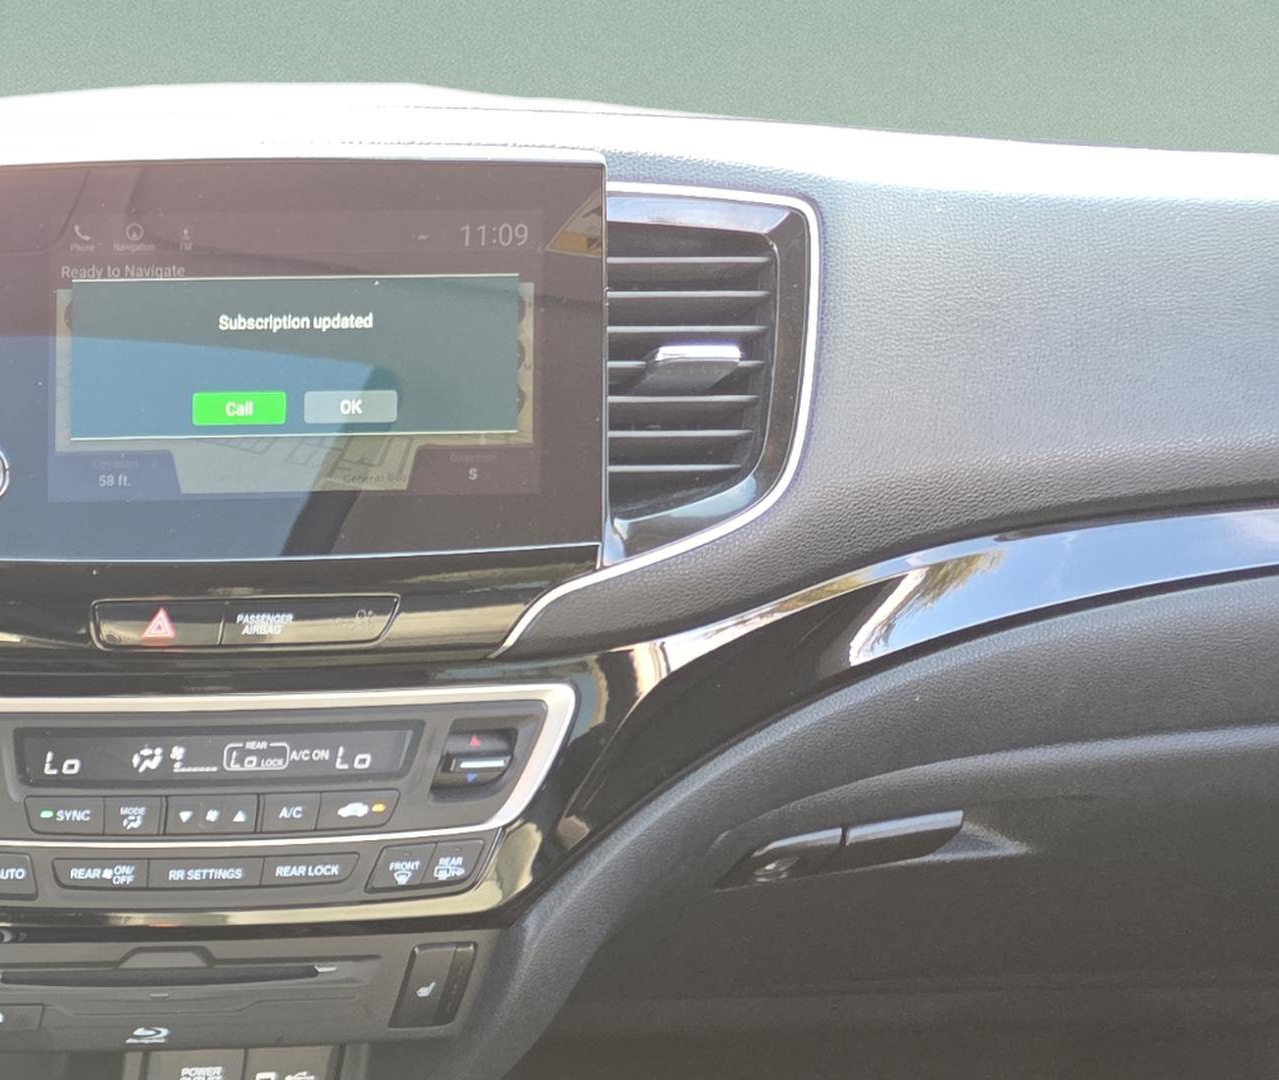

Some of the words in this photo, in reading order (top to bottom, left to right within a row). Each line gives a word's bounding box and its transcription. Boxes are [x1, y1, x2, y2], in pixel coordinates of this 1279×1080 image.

[460, 223, 528, 247] 11:09
[61, 266, 103, 279] Ready
[107, 267, 120, 278] to
[125, 265, 185, 278] Navigate
[219, 315, 310, 332] Subscription
[313, 312, 374, 331] updated
[225, 401, 254, 416] Call
[340, 401, 363, 415] OK
[469, 468, 477, 480] S
[99, 475, 114, 487] 58
[118, 475, 131, 486] ft.
[236, 612, 294, 624] PASSENGER
[242, 623, 282, 635] AIRBAG
[245, 741, 267, 749] REAR
[290, 750, 310, 761] A/C
[312, 749, 329, 760] ON
[261, 758, 284, 767] LOCK
[56, 810, 91, 821] SYNC
[120, 807, 146, 816] MODE
[279, 806, 303, 818] A/C
[389, 860, 420, 871] FRONT
[439, 857, 463, 866] REAR
[70, 868, 100, 879] REAR
[168, 869, 185, 881] RR
[187, 868, 242, 880] SETTINGS
[275, 866, 305, 877] REAR
[308, 864, 339, 876] LOCK
[113, 875, 134, 885] OFF
[180, 1066, 223, 1077] POWER
